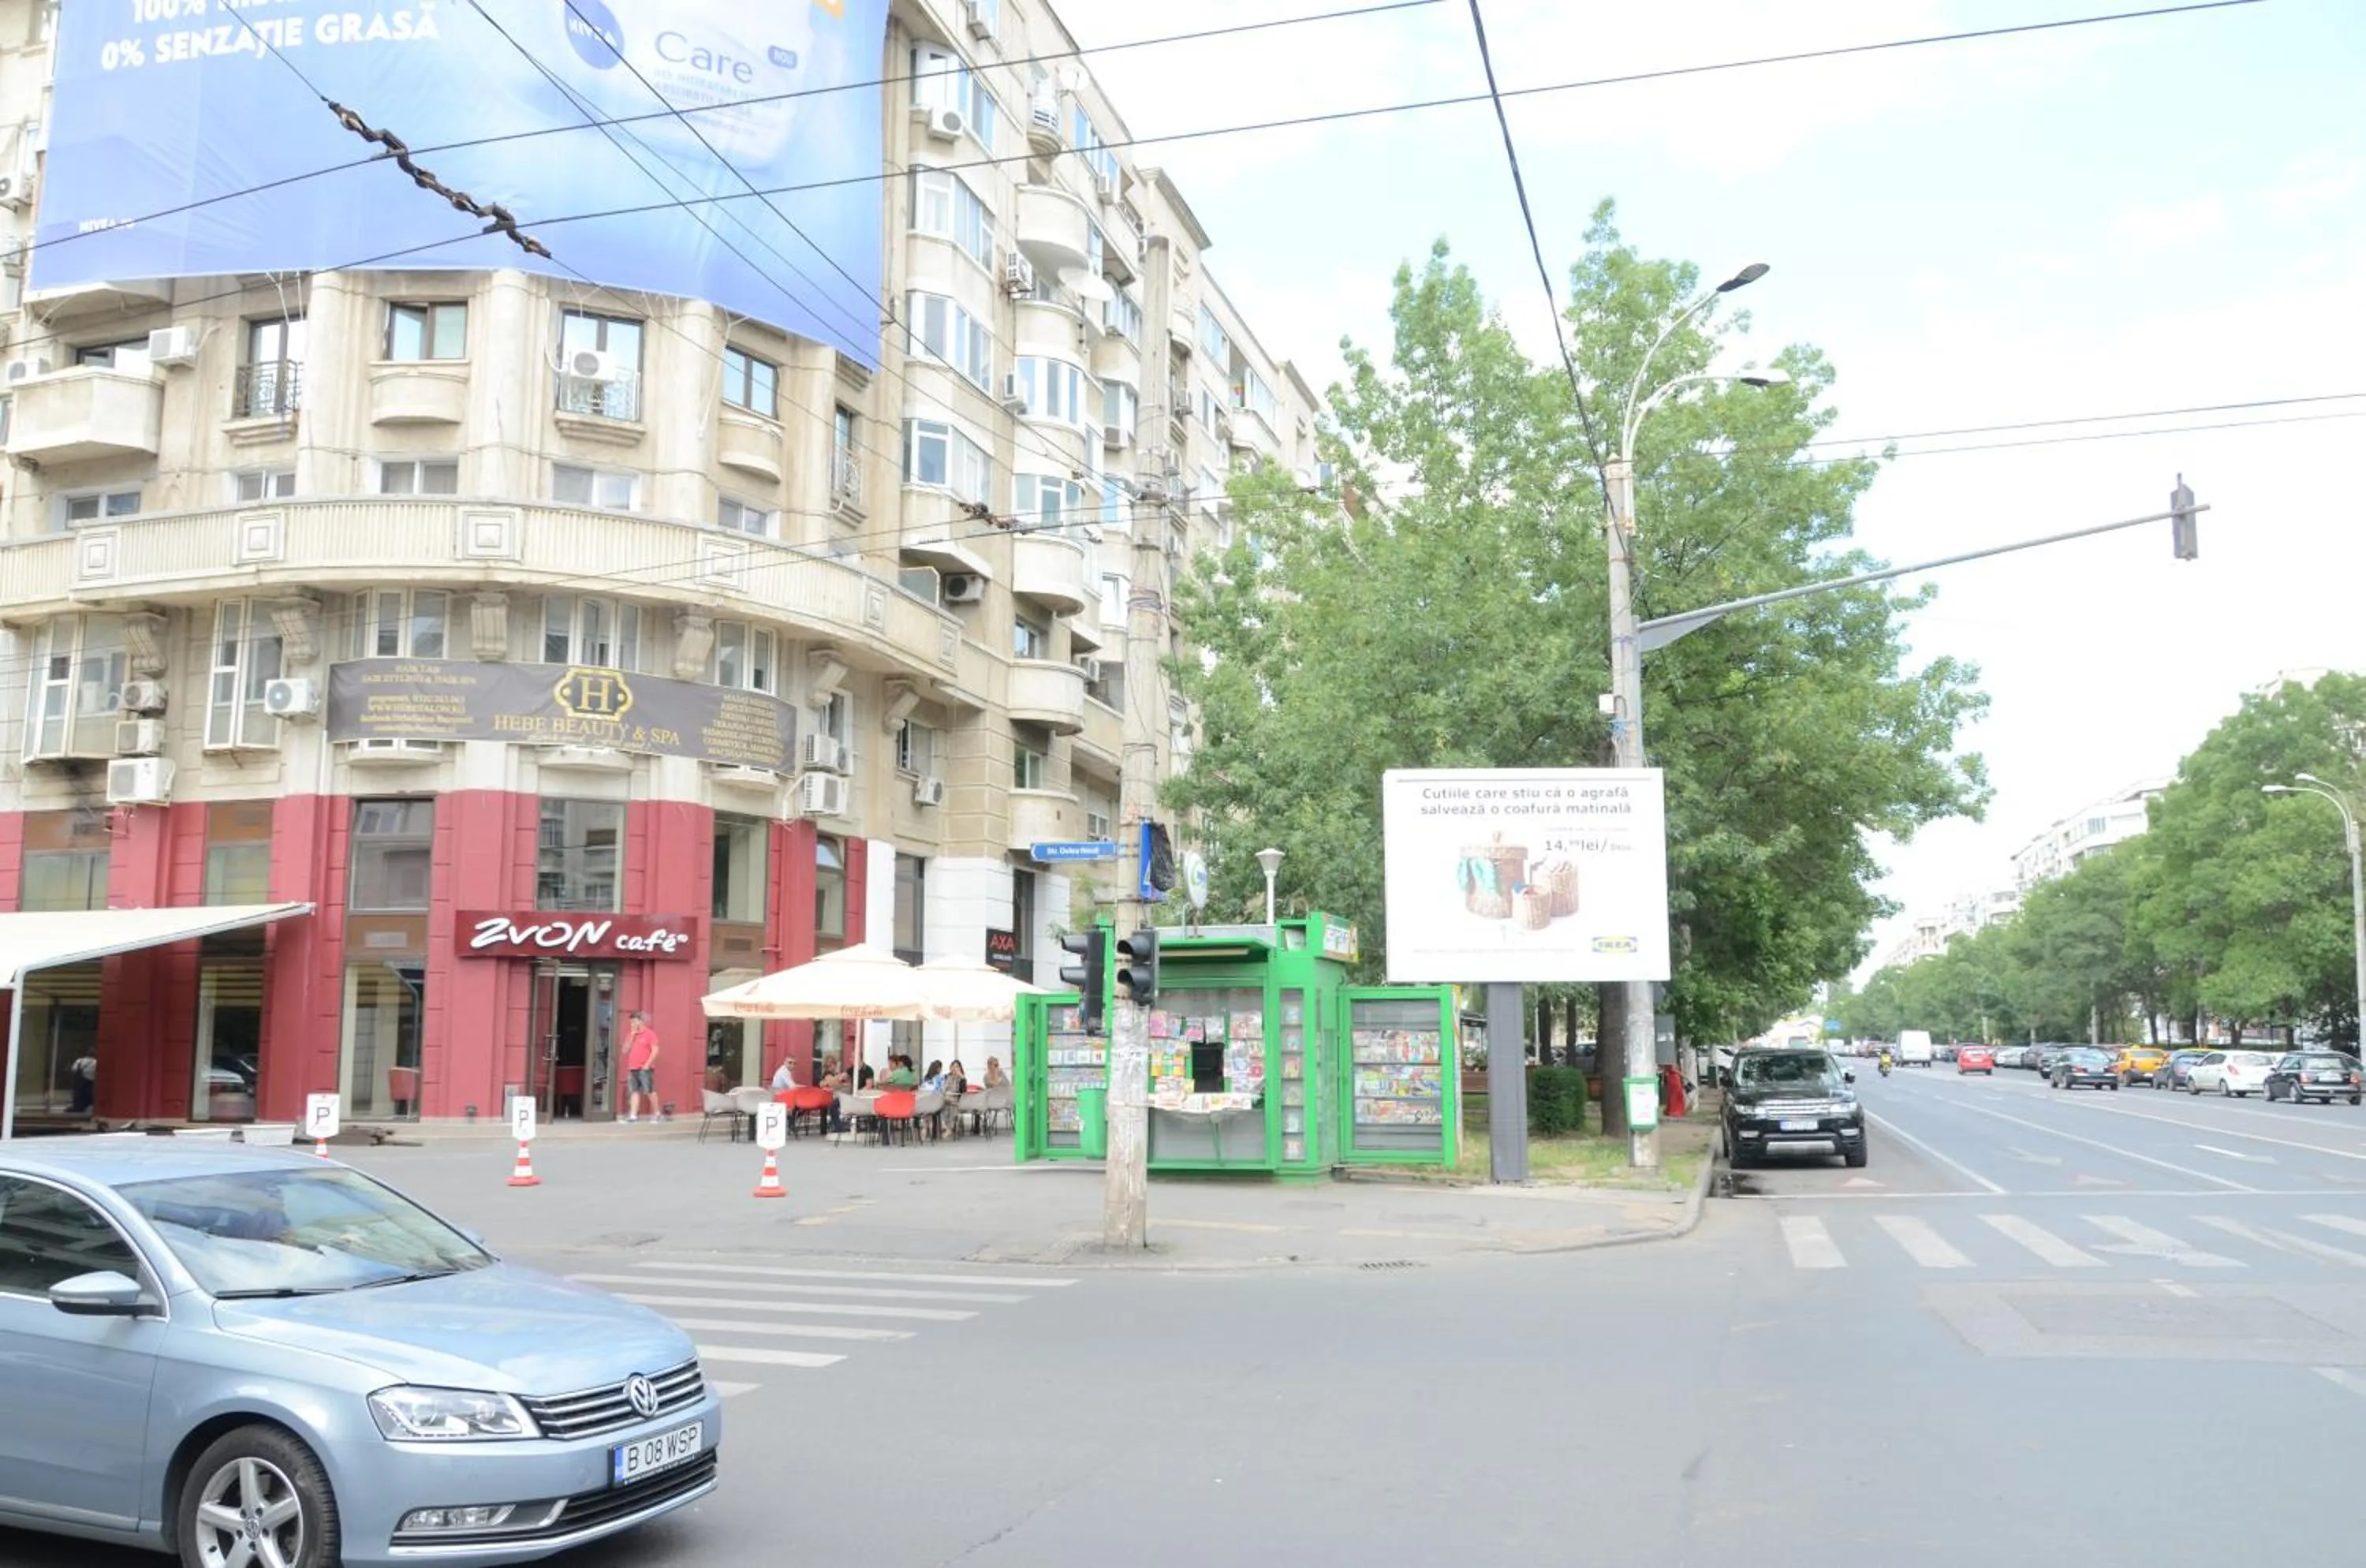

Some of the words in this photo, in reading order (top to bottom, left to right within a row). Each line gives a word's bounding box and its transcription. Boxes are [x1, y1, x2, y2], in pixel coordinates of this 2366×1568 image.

[101, 39, 145, 71] 0%
[315, 1, 442, 44] GRASĂ
[567, 17, 618, 48] NIVEA
[654, 31, 754, 84] Care
[576, 676, 615, 712] H
[494, 714, 547, 732] HEBE
[552, 717, 629, 742] BEAUTY
[633, 726, 647, 741] &
[651, 727, 681, 746] SPA
[1422, 787, 1471, 799] Cutiile
[1475, 789, 1507, 799] care
[1567, 790, 1576, 799] o
[1491, 805, 1500, 815] o
[615, 928, 677, 952] café
[990, 933, 1016, 951] AXA
[316, 1107, 330, 1125] P
[518, 1110, 529, 1128] P
[765, 1116, 778, 1135] P
[627, 1446, 640, 1472] B
[644, 1439, 662, 1465] 08
[666, 1426, 698, 1459] WSP
